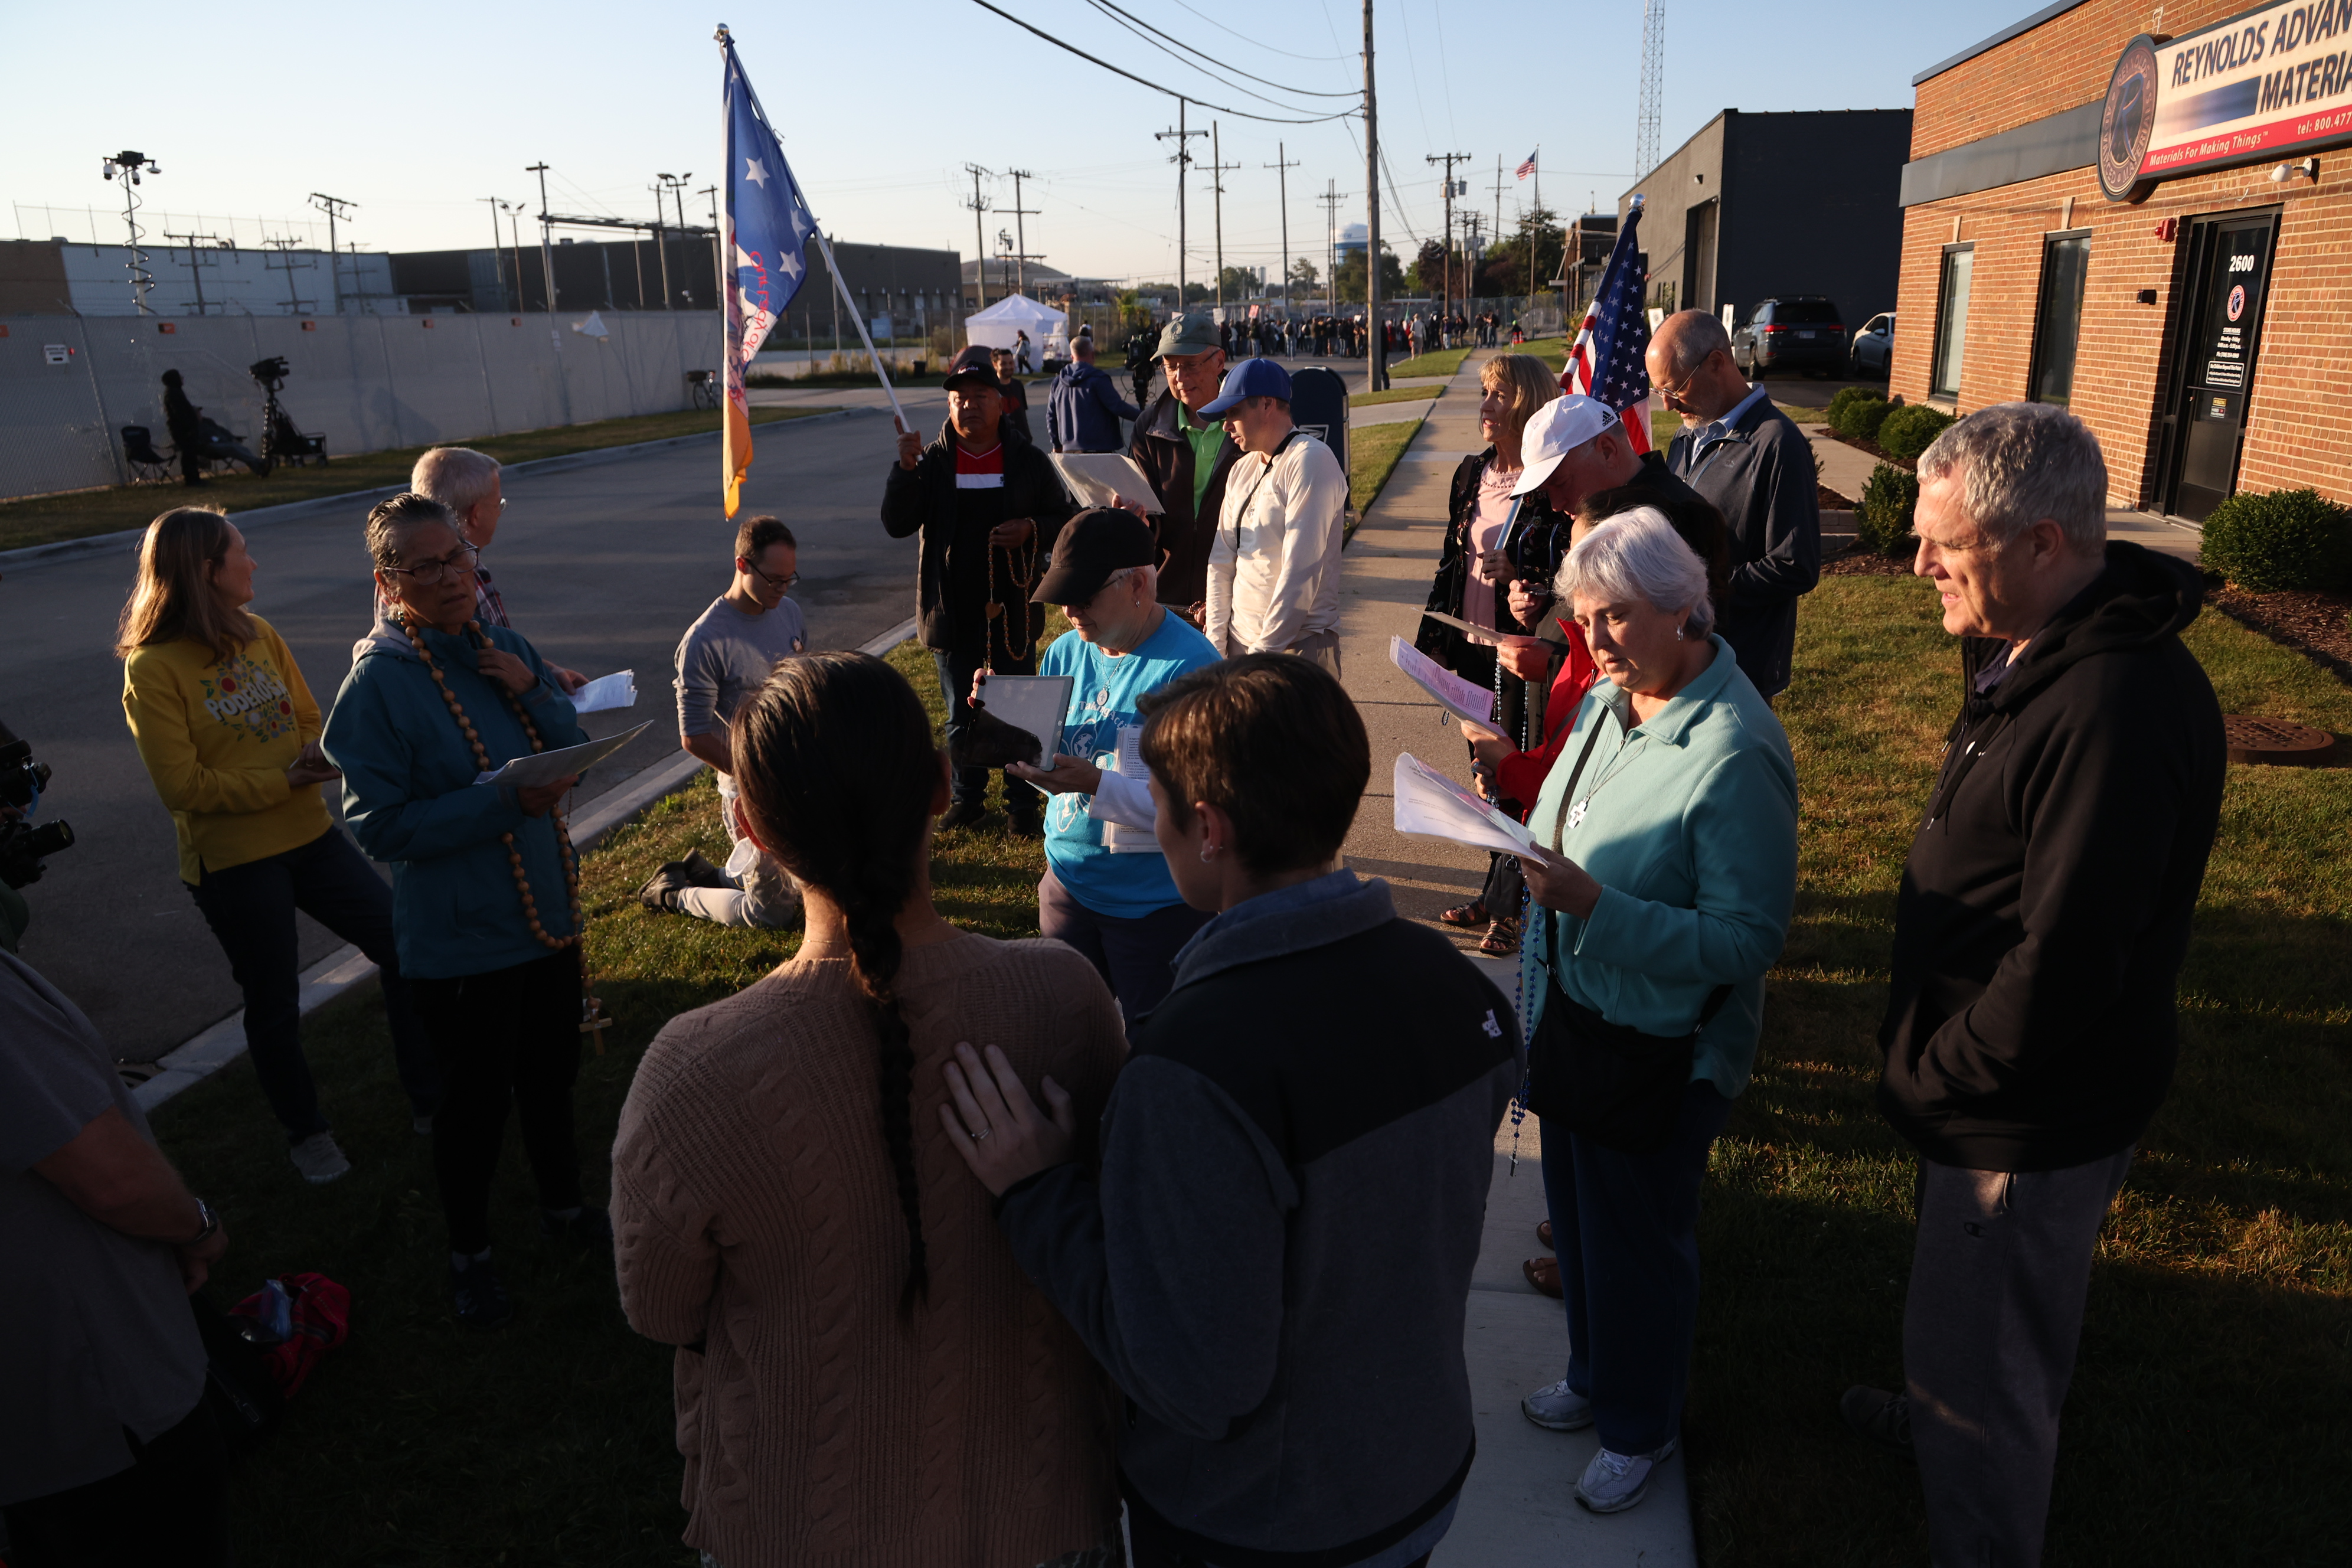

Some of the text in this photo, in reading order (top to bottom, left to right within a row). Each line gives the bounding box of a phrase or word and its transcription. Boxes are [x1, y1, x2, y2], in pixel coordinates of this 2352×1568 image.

[2171, 0, 2352, 89] REYNOLDS ADVAN
[2297, 119, 2312, 135] tel:
[2149, 148, 2184, 166] Materials
[2184, 146, 2199, 159] For
[2199, 140, 2230, 154] Making
[2229, 254, 2255, 272] 2600
[1079, 701, 1111, 718] Taking
[1108, 710, 1127, 730] Act
